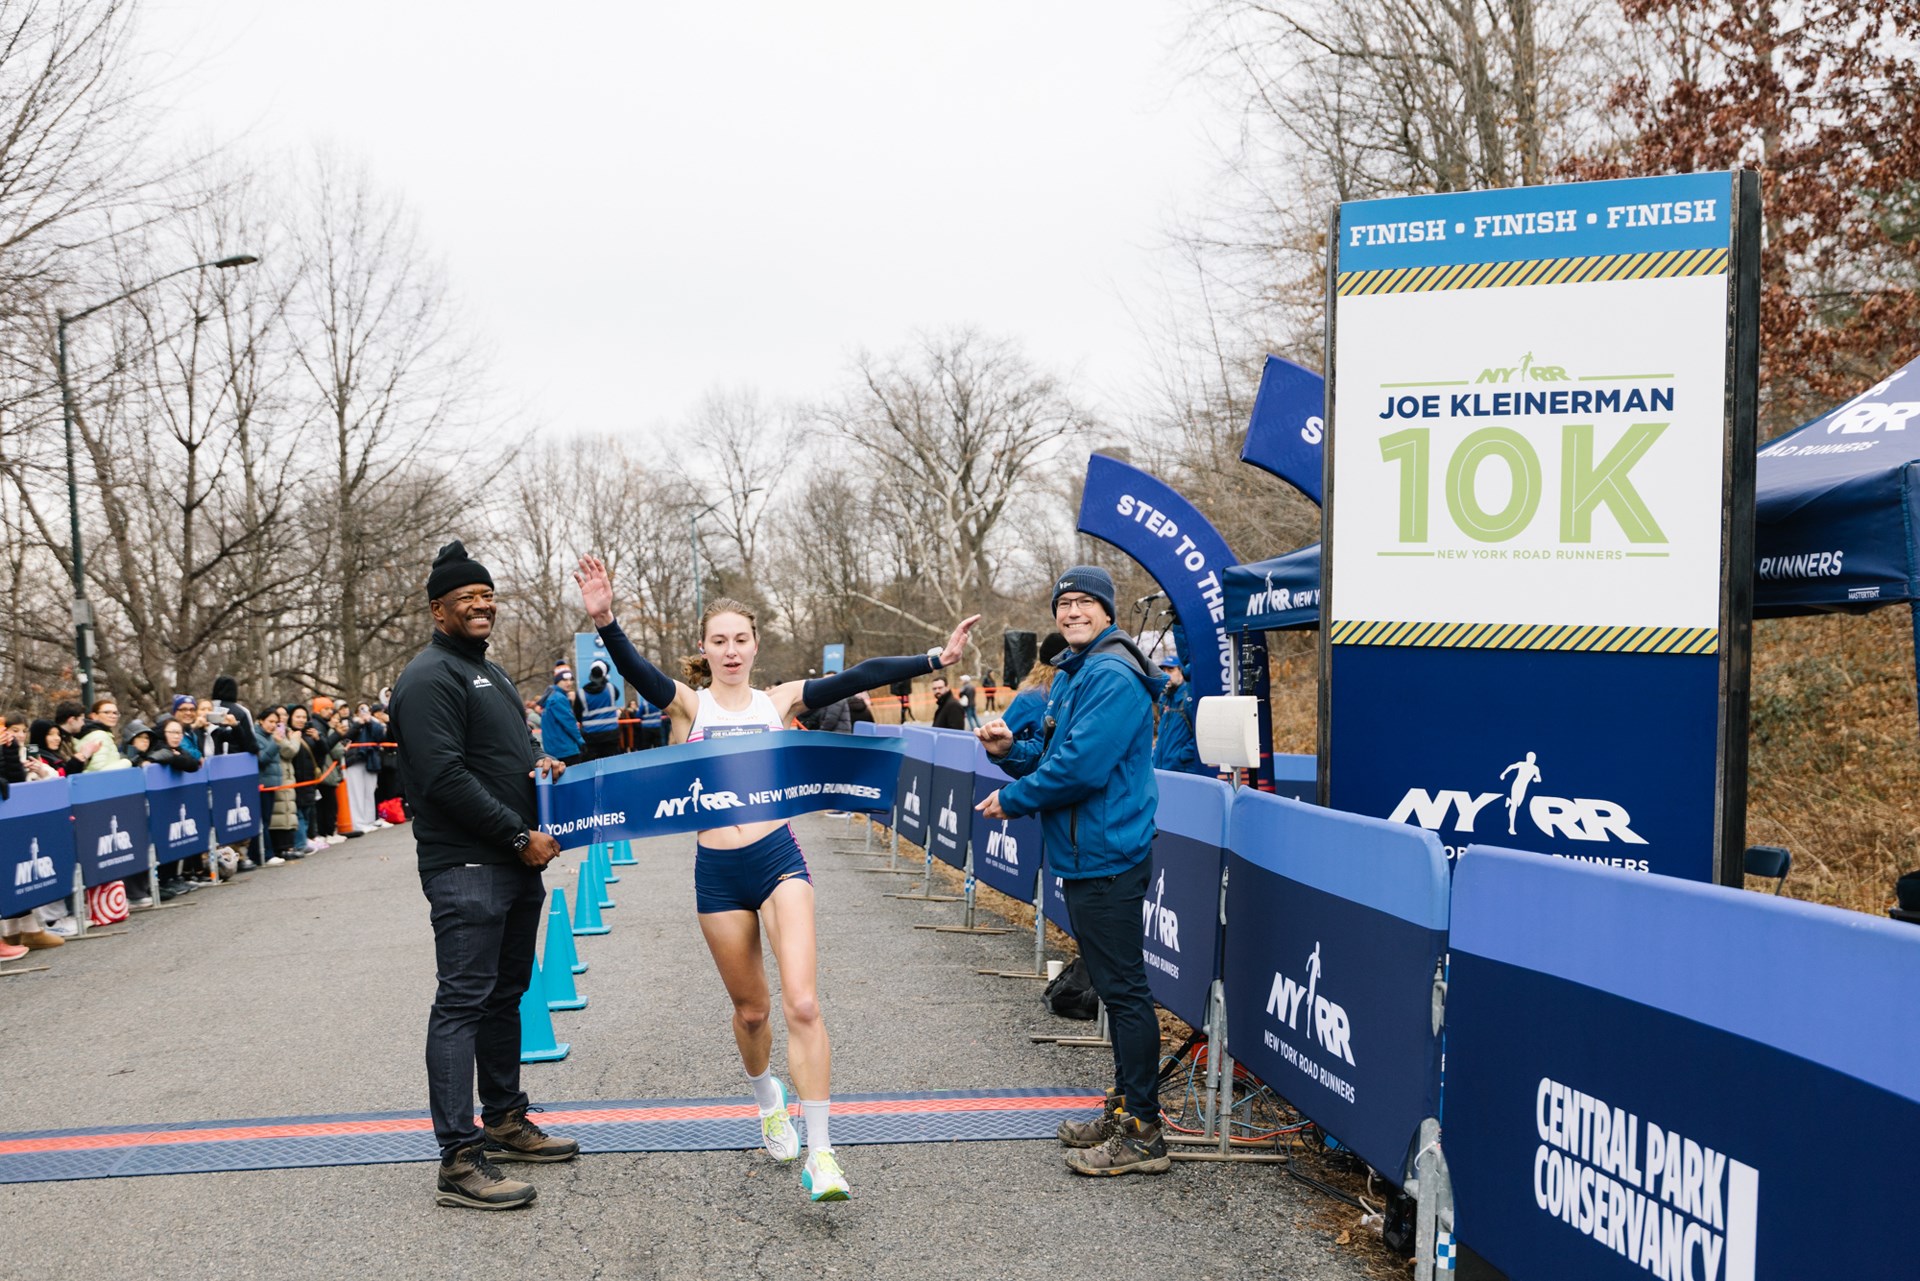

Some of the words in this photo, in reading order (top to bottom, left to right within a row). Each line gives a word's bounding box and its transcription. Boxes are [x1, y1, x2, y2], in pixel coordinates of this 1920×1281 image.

[1350, 219, 1446, 247] FINISH
[1474, 210, 1577, 238] FINISH
[1607, 199, 1717, 229] FINISH
[1379, 395, 1440, 420] JOE
[1450, 387, 1675, 418] KLEINERMAN
[1793, 440, 1880, 457] RUNNERS
[1379, 422, 1671, 544] 10K
[1117, 494, 1178, 538] STEP
[1175, 534, 1205, 572] TO
[1197, 570, 1225, 624] THE
[1437, 549, 1468, 560] NEW
[1471, 549, 1508, 560] YORK
[1512, 549, 1551, 561] ROAD
[1556, 550, 1623, 561] RUNNERS
[1759, 550, 1844, 580] RUNNERS
[1293, 590, 1314, 609] NEW
[748, 789, 783, 805] NEW
[783, 785, 800, 800] YORK
[799, 783, 822, 798] ROAD
[822, 783, 882, 799] RUNNERS
[576, 811, 626, 831] RUNNERS
[1160, 957, 1180, 980] RUNNERS
[1264, 1029, 1280, 1053] NEW
[1280, 1039, 1298, 1067] YORK
[1299, 1052, 1319, 1080] ROAD
[1319, 1066, 1356, 1104] RUNNERS
[1536, 1077, 1642, 1188] CENTRAL
[1644, 1121, 1727, 1231] PARK
[1534, 1144, 1725, 1281] CONSERVANCY
